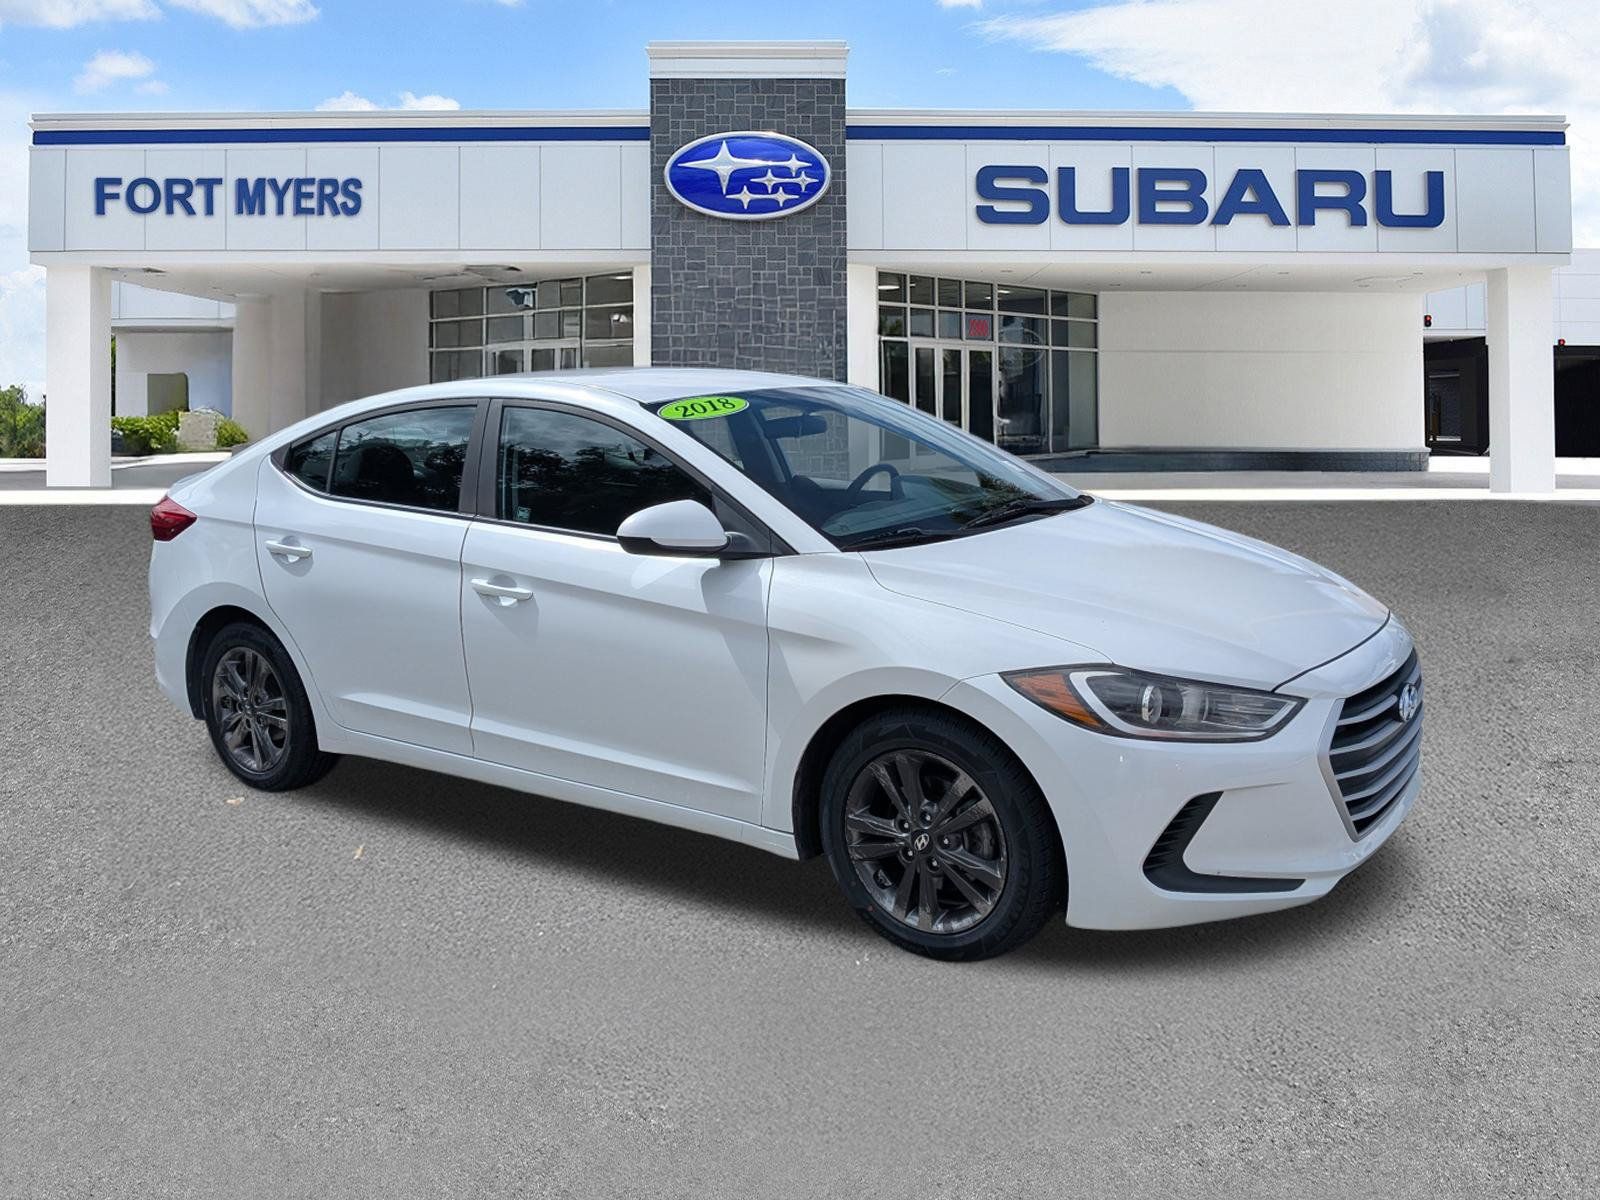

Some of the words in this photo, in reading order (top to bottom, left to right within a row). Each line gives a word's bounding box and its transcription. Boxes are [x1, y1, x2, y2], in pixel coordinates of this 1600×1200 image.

[95, 178, 223, 216] FORT
[235, 178, 363, 216] MYERS
[976, 165, 1445, 228] SUBARU
[675, 398, 735, 417] 2018
